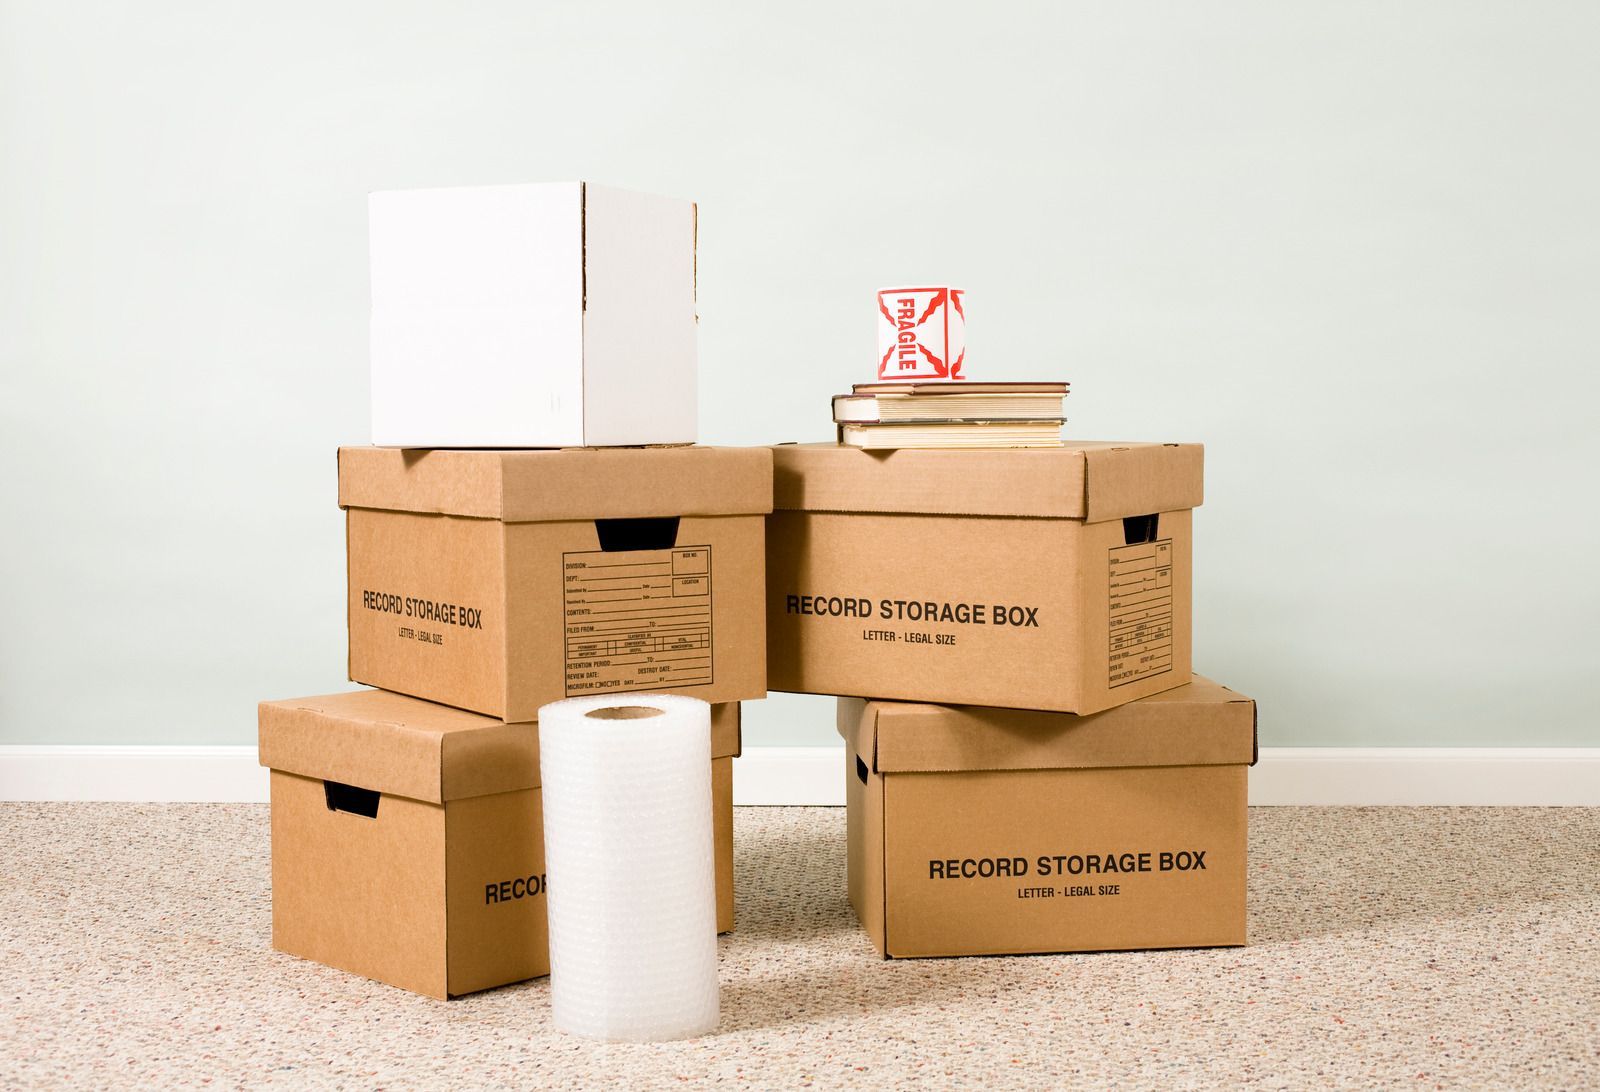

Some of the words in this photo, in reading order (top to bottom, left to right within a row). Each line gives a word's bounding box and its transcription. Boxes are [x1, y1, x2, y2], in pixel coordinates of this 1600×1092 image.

[897, 298, 917, 370] FRAGILE
[363, 590, 403, 615] RECORD
[405, 597, 457, 625] STORAGE
[459, 606, 482, 630] BOX
[785, 594, 873, 618] RECORD
[879, 599, 986, 625] STORAGE
[993, 605, 1040, 628] BOX
[398, 626, 415, 640] LETTER
[418, 630, 432, 643] LEGAL
[432, 633, 443, 645] SIZE
[863, 629, 896, 642] LETTER
[904, 631, 933, 644] LEGAL
[935, 633, 956, 646] SIZE
[929, 857, 1029, 879] RECORD
[1036, 852, 1152, 876] STORAGE
[1159, 850, 1207, 872] BOX
[1018, 887, 1055, 899] LETTER
[1064, 886, 1096, 897] LEGAL
[1098, 884, 1120, 896] SIZE
